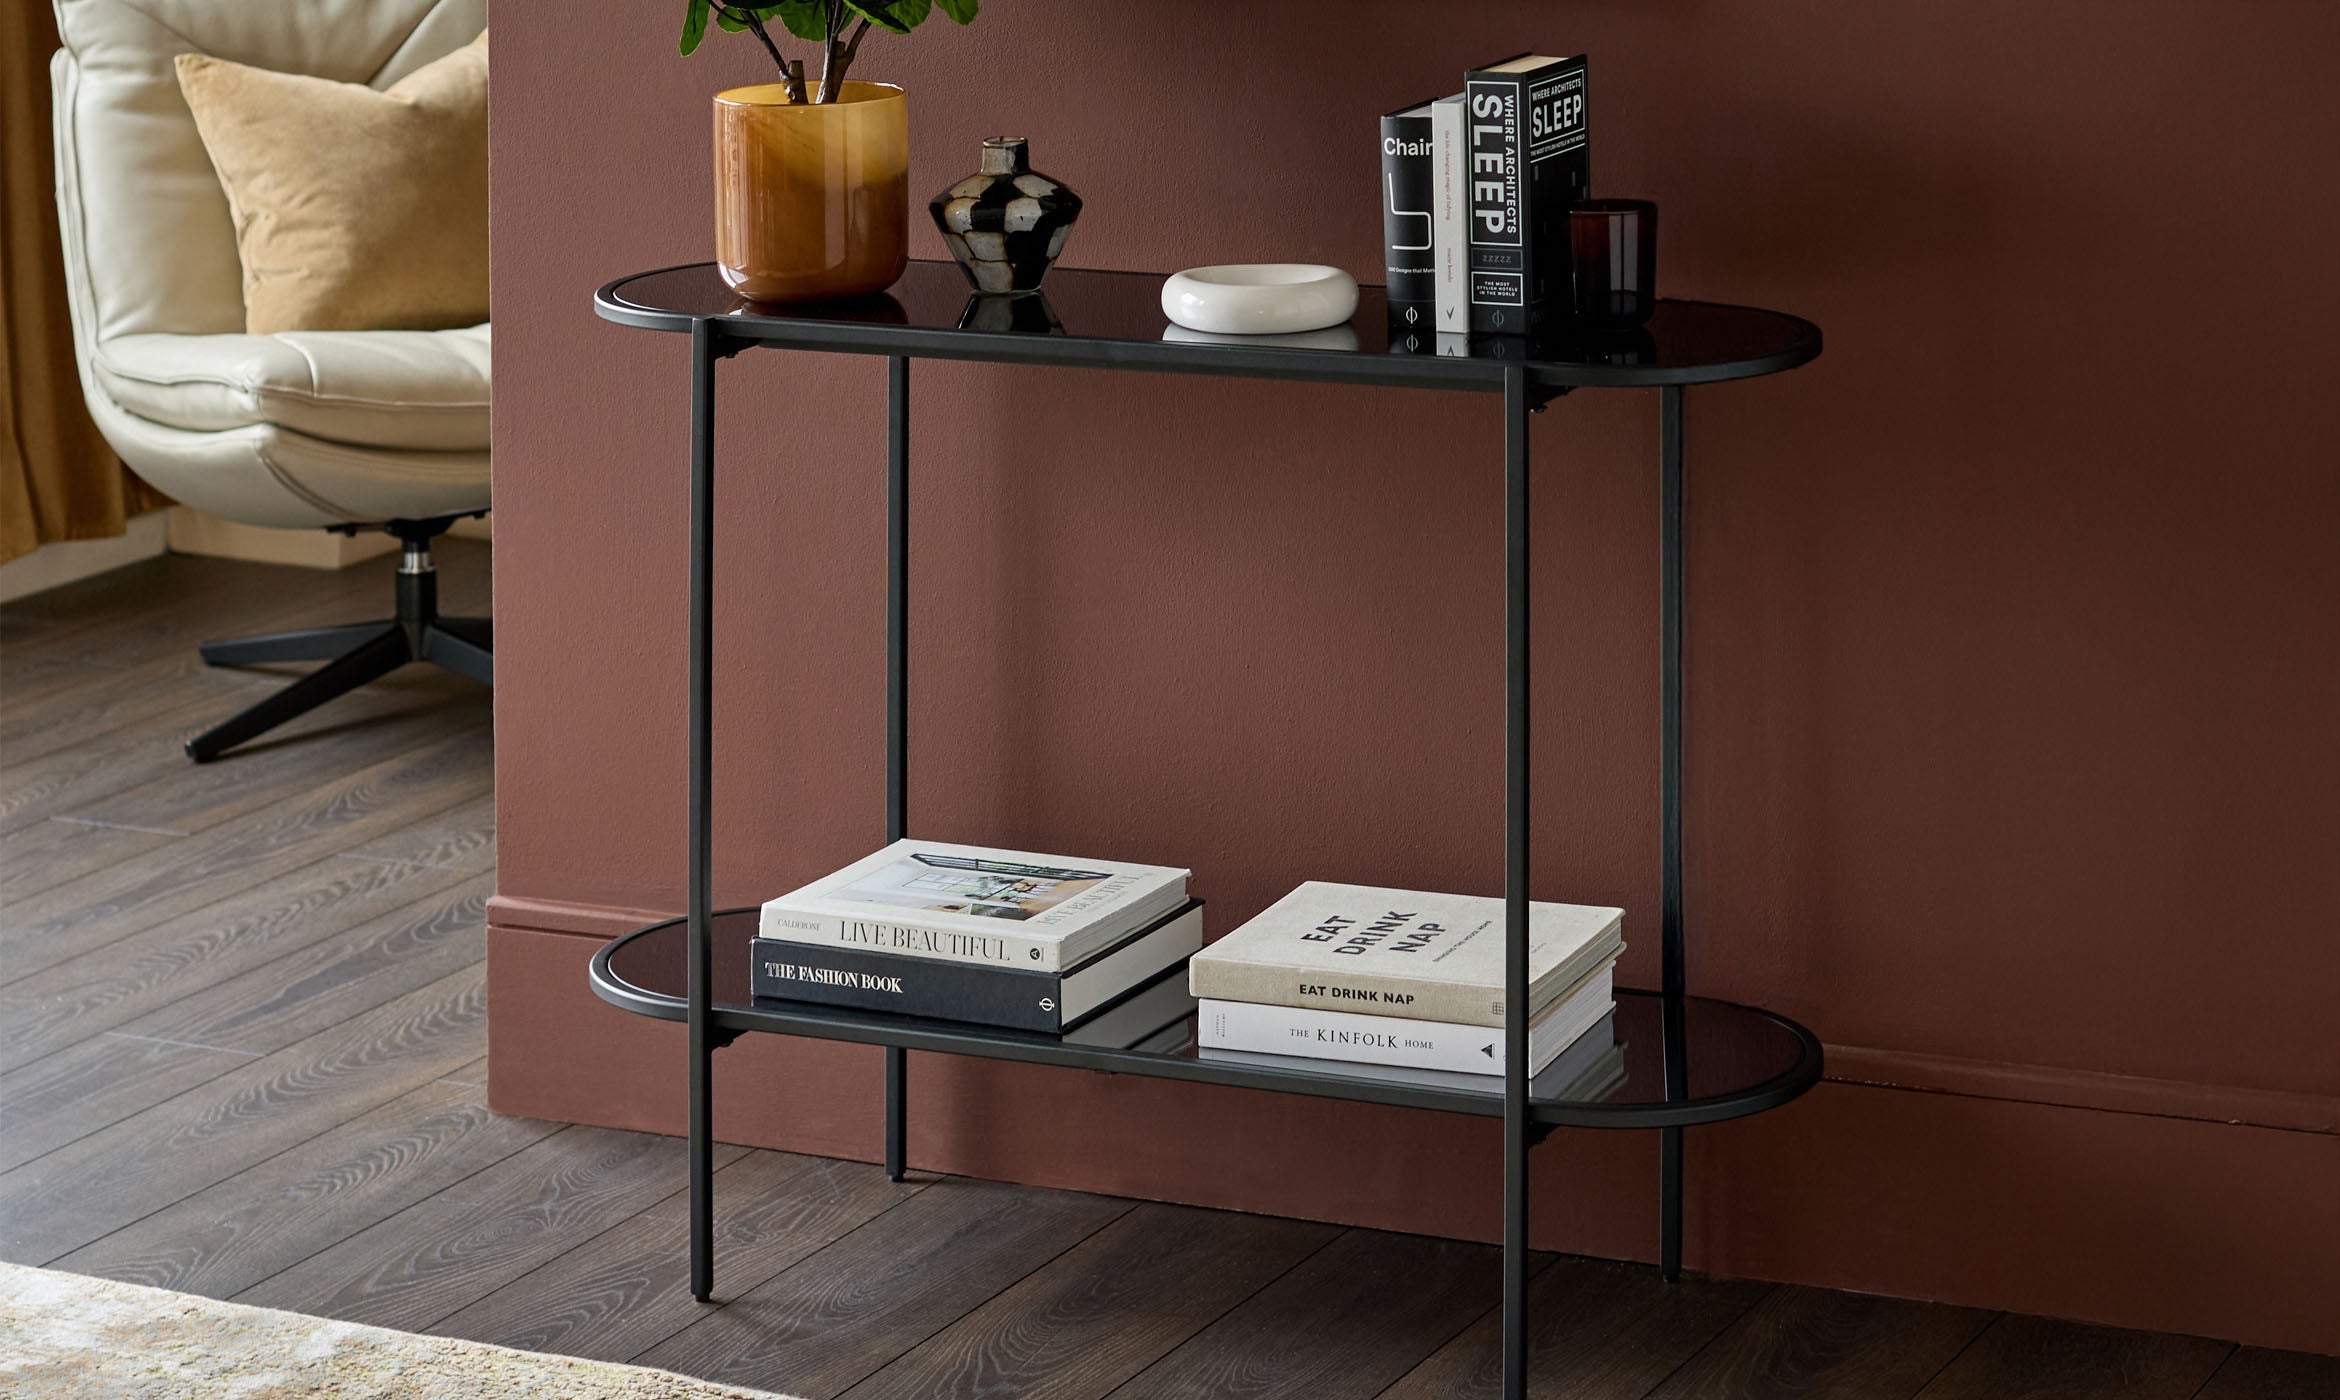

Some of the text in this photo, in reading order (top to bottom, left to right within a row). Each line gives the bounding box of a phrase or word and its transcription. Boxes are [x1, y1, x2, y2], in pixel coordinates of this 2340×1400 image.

[1532, 78, 1582, 101] WHERE ARCHITECTS
[1532, 94, 1582, 138] SLEEP
[1383, 137, 1433, 156] Chair
[1472, 93, 1505, 233] SLEEP
[1504, 94, 1517, 234] WHERE ARCHITECTS
[777, 919, 821, 932] CALDERONE
[840, 920, 887, 946] LIVE
[892, 926, 1011, 961] BEAUTIFUL
[1300, 915, 1356, 942] EAT
[1332, 911, 1418, 955] DRINK
[1388, 922, 1446, 953] NAP
[764, 962, 904, 994] THE FASHION BOOK
[1299, 984, 1415, 1005] EAT DRINK NAP
[1289, 1028, 1435, 1050] THE KINFOLK HOME
